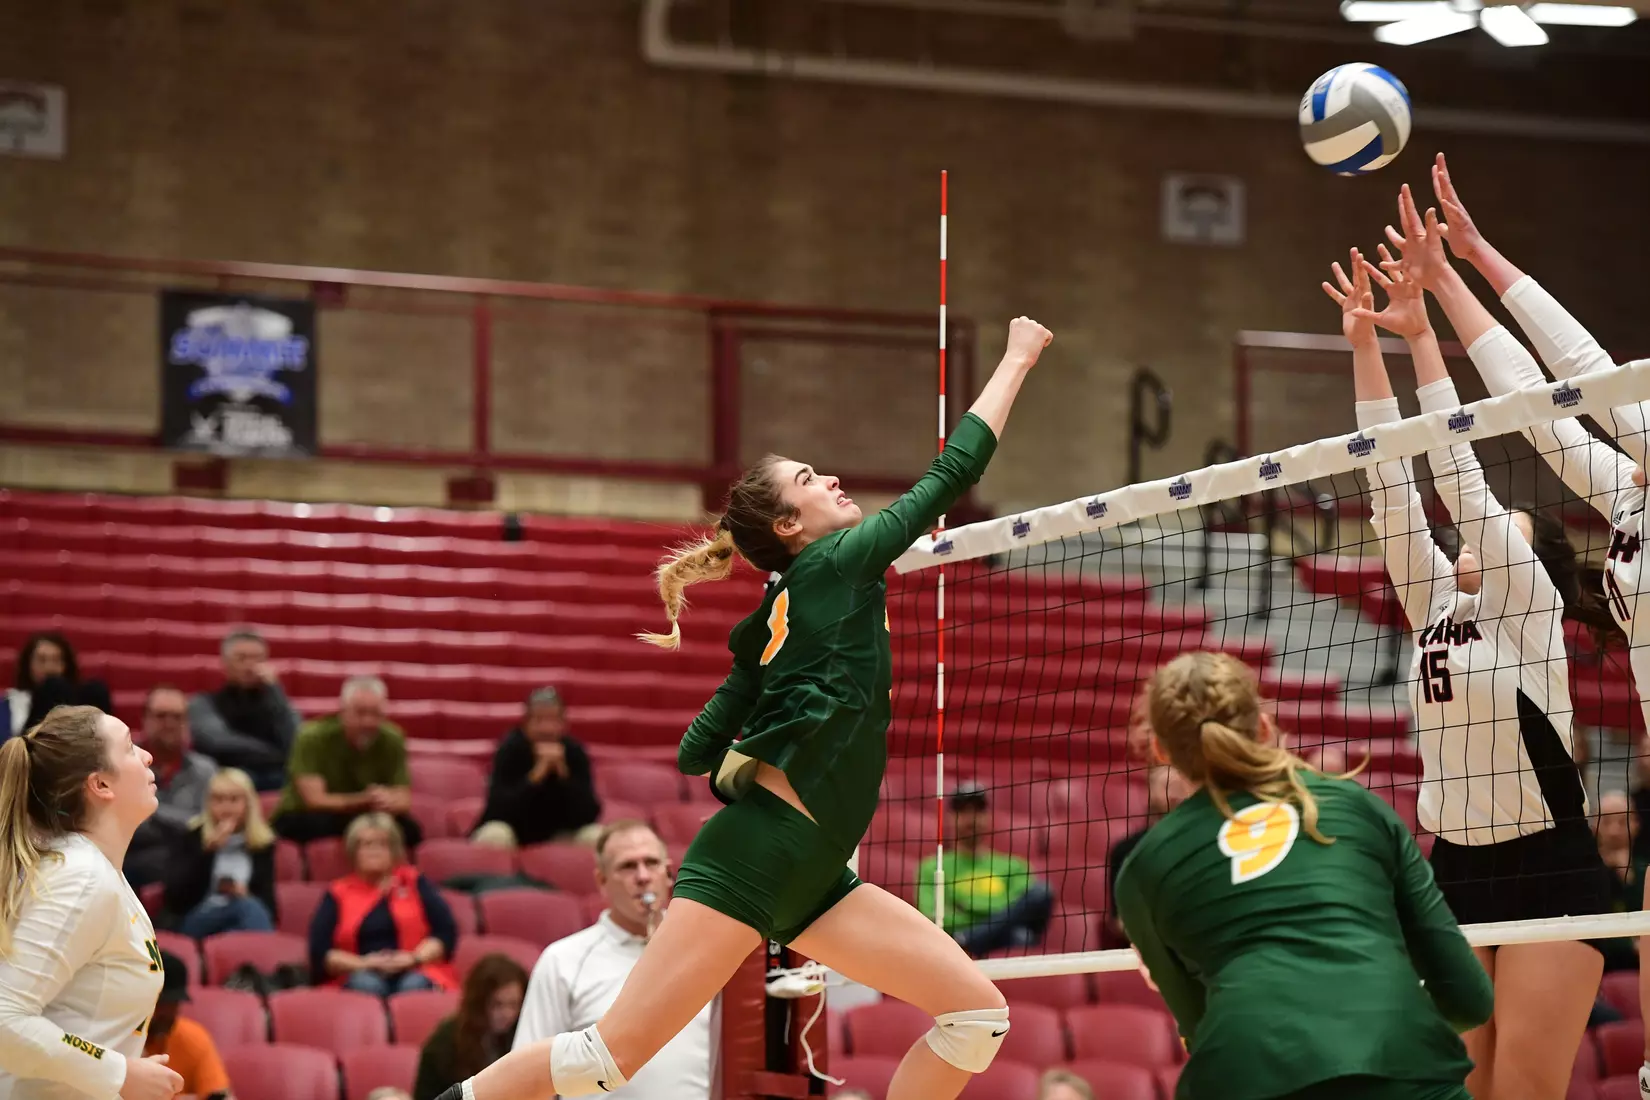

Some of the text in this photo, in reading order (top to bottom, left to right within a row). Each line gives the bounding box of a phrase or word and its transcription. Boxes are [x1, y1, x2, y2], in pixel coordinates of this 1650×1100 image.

[1552, 387, 1583, 406] SUMMIT
[1447, 413, 1475, 431] SUMMIT
[1347, 437, 1376, 455] SUMMIT
[1420, 649, 1454, 704] 15
[1217, 801, 1300, 885] 9
[61, 1032, 106, 1060] BISON
